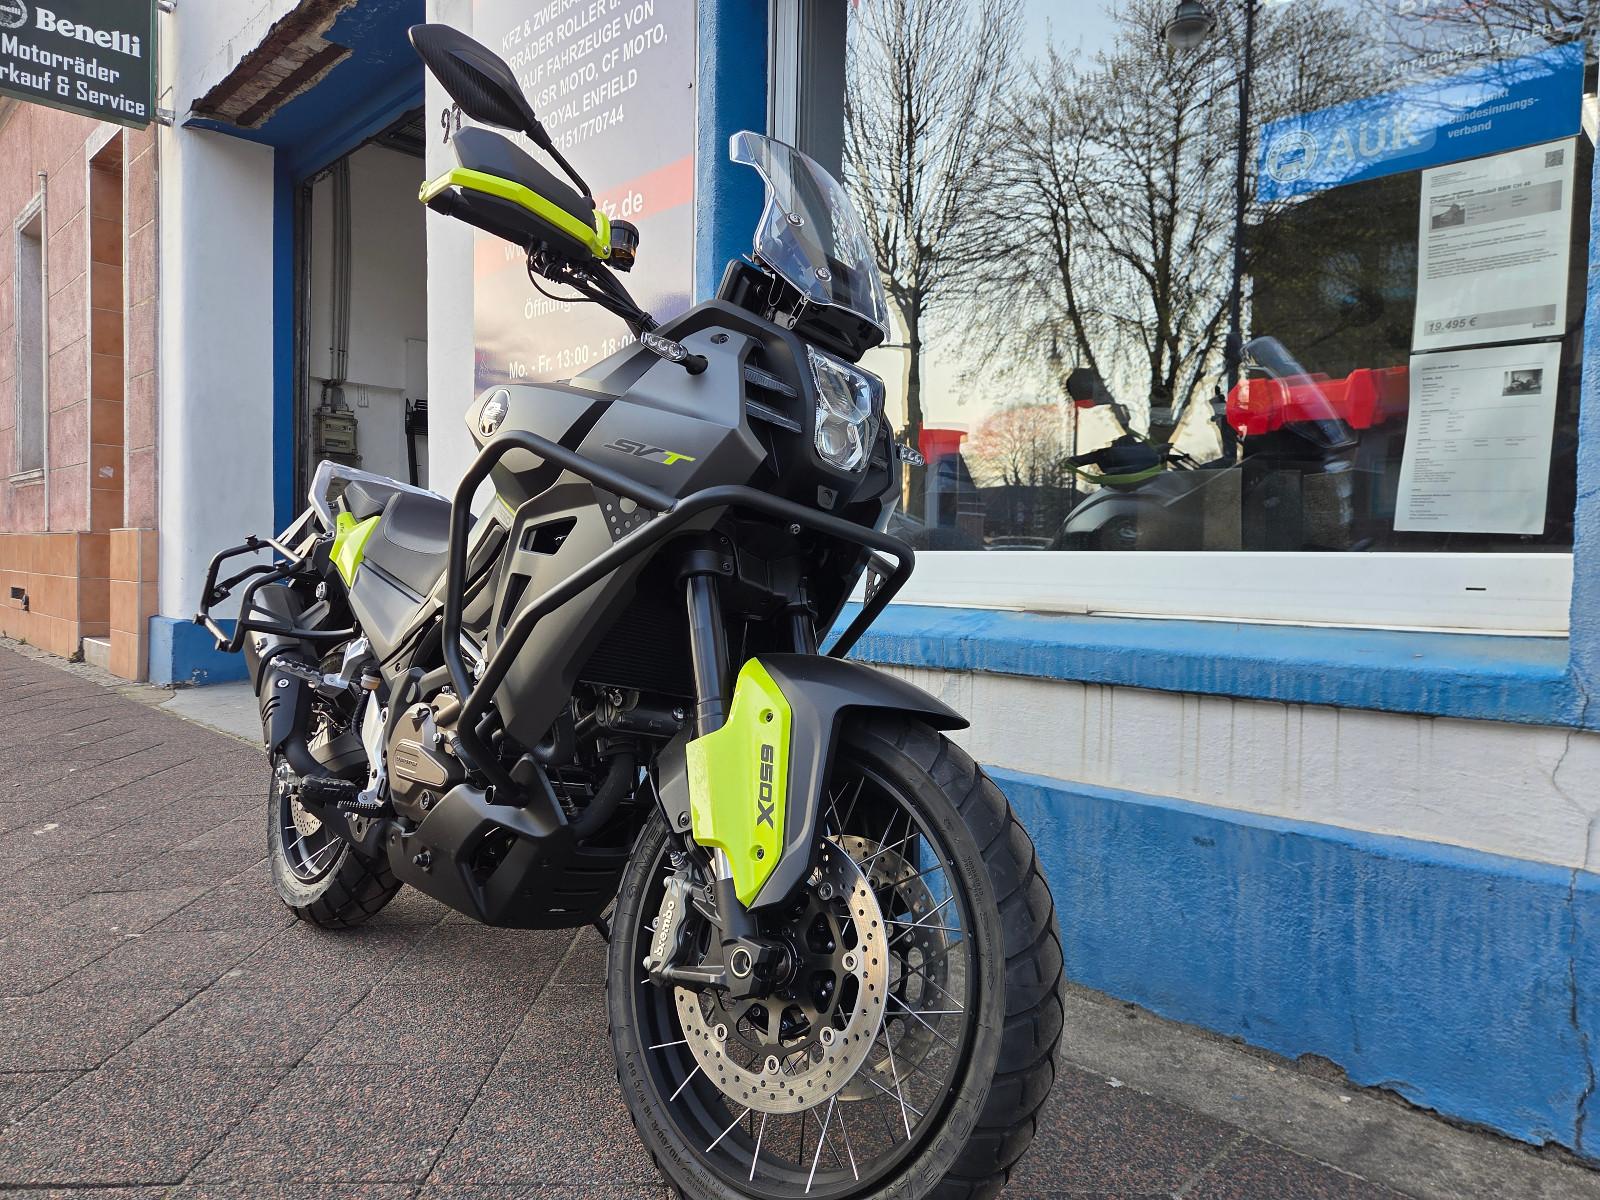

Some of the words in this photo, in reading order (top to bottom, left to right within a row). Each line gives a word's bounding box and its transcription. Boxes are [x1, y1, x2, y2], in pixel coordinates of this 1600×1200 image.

[34, 6, 142, 58] Benelli
[501, 25, 522, 53] KFZ
[523, 19, 531, 37] &
[533, 0, 581, 32] ZWEIR
[507, 31, 554, 71] RRÄDER
[556, 0, 606, 43] ROLLER
[547, 16, 621, 76] FAHRZEUGE
[624, 0, 654, 30] VON
[1389, 41, 1484, 77] AUTHORIZED
[1489, 22, 1552, 50] DEALER
[2, 32, 120, 84] Motorräder
[534, 87, 557, 112] KSR
[560, 62, 599, 97] MOTO,
[602, 48, 620, 73] CF
[623, 23, 668, 62] MOTO,
[0, 62, 51, 92] rkauf
[57, 74, 70, 97] &
[76, 80, 145, 117] Service
[542, 101, 580, 132] ROYAL
[583, 68, 638, 113] ENFIELD
[1448, 97, 1540, 125] Bundesinnungs-
[551, 103, 625, 153] 2151/770744
[1447, 119, 1492, 139] verband
[1469, 316, 1478, 327] €
[508, 360, 528, 380] Mo.
[538, 354, 553, 374] Fr.
[557, 344, 589, 369] 13:00
[603, 437, 697, 466] SVT
[756, 743, 775, 831] 650X
[655, 900, 676, 957] brembo
